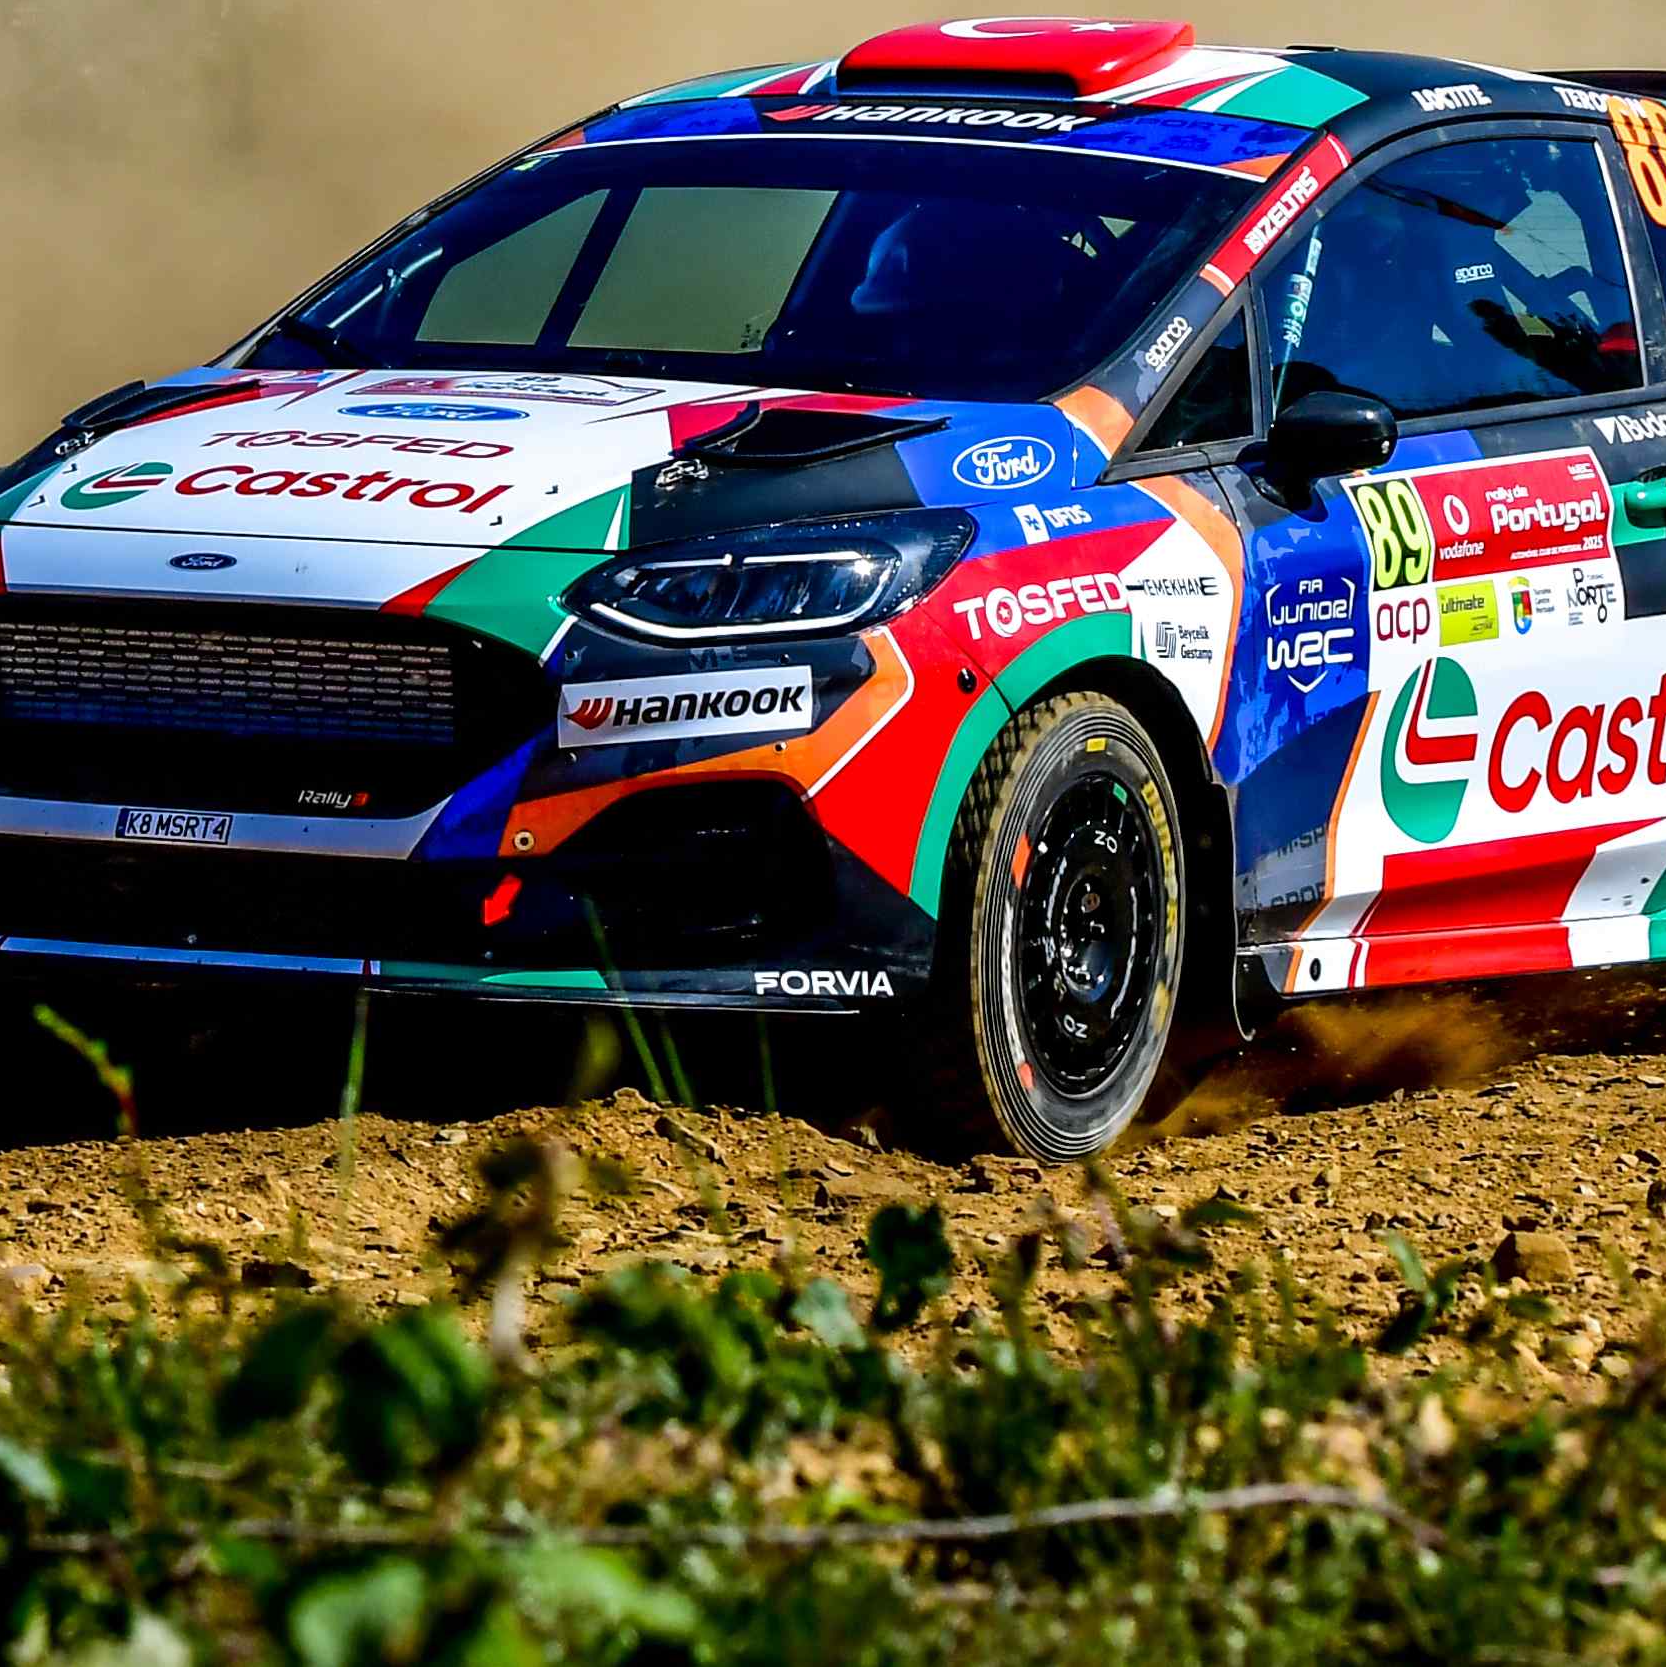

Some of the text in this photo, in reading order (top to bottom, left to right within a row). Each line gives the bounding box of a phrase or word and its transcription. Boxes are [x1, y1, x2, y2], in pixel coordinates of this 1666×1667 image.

[1454, 262, 1494, 281] sparco
[1145, 316, 1189, 368] sparco
[201, 430, 515, 460] TOSFED
[971, 443, 1040, 485] Ford
[174, 464, 515, 515] Castrol
[1485, 486, 1515, 503] rally
[1042, 504, 1093, 529] DFDS
[1490, 491, 1606, 534] Portugal
[1356, 480, 1431, 588] 89
[1582, 534, 1604, 551] 2025
[1439, 541, 1485, 561] vodafone
[1298, 578, 1323, 595] FIA
[953, 573, 1130, 641] TOSFED
[1271, 599, 1349, 625] JUNIOR
[1440, 594, 1485, 615] ultimate
[1376, 597, 1431, 645] acp
[1267, 628, 1357, 669] WRC
[126, 812, 229, 841] K8 MSRT4
[754, 970, 895, 998] FORVIA
